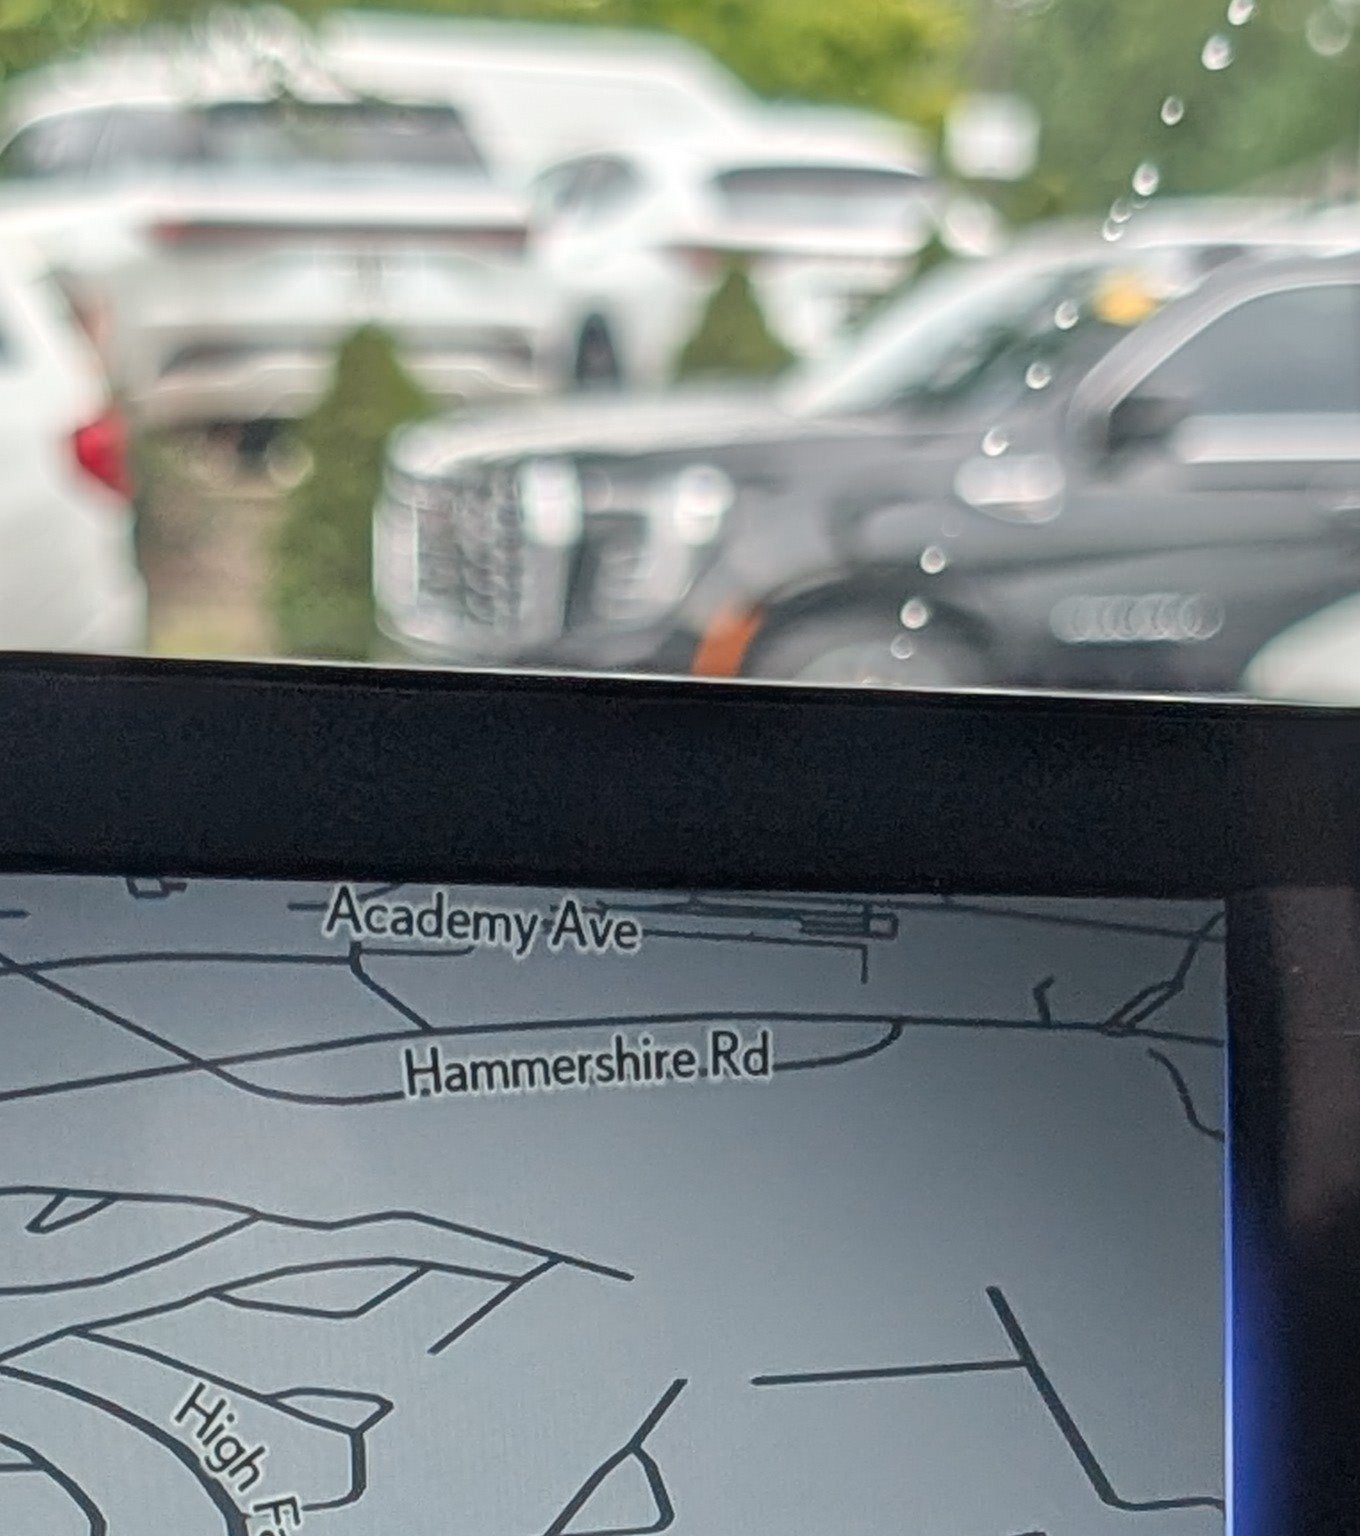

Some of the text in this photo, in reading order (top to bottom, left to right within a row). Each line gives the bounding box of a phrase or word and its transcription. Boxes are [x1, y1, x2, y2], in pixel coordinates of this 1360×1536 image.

[326, 886, 639, 955] Academy Ave
[405, 1030, 770, 1097] Hammershire Rd
[174, 1383, 266, 1493] High
